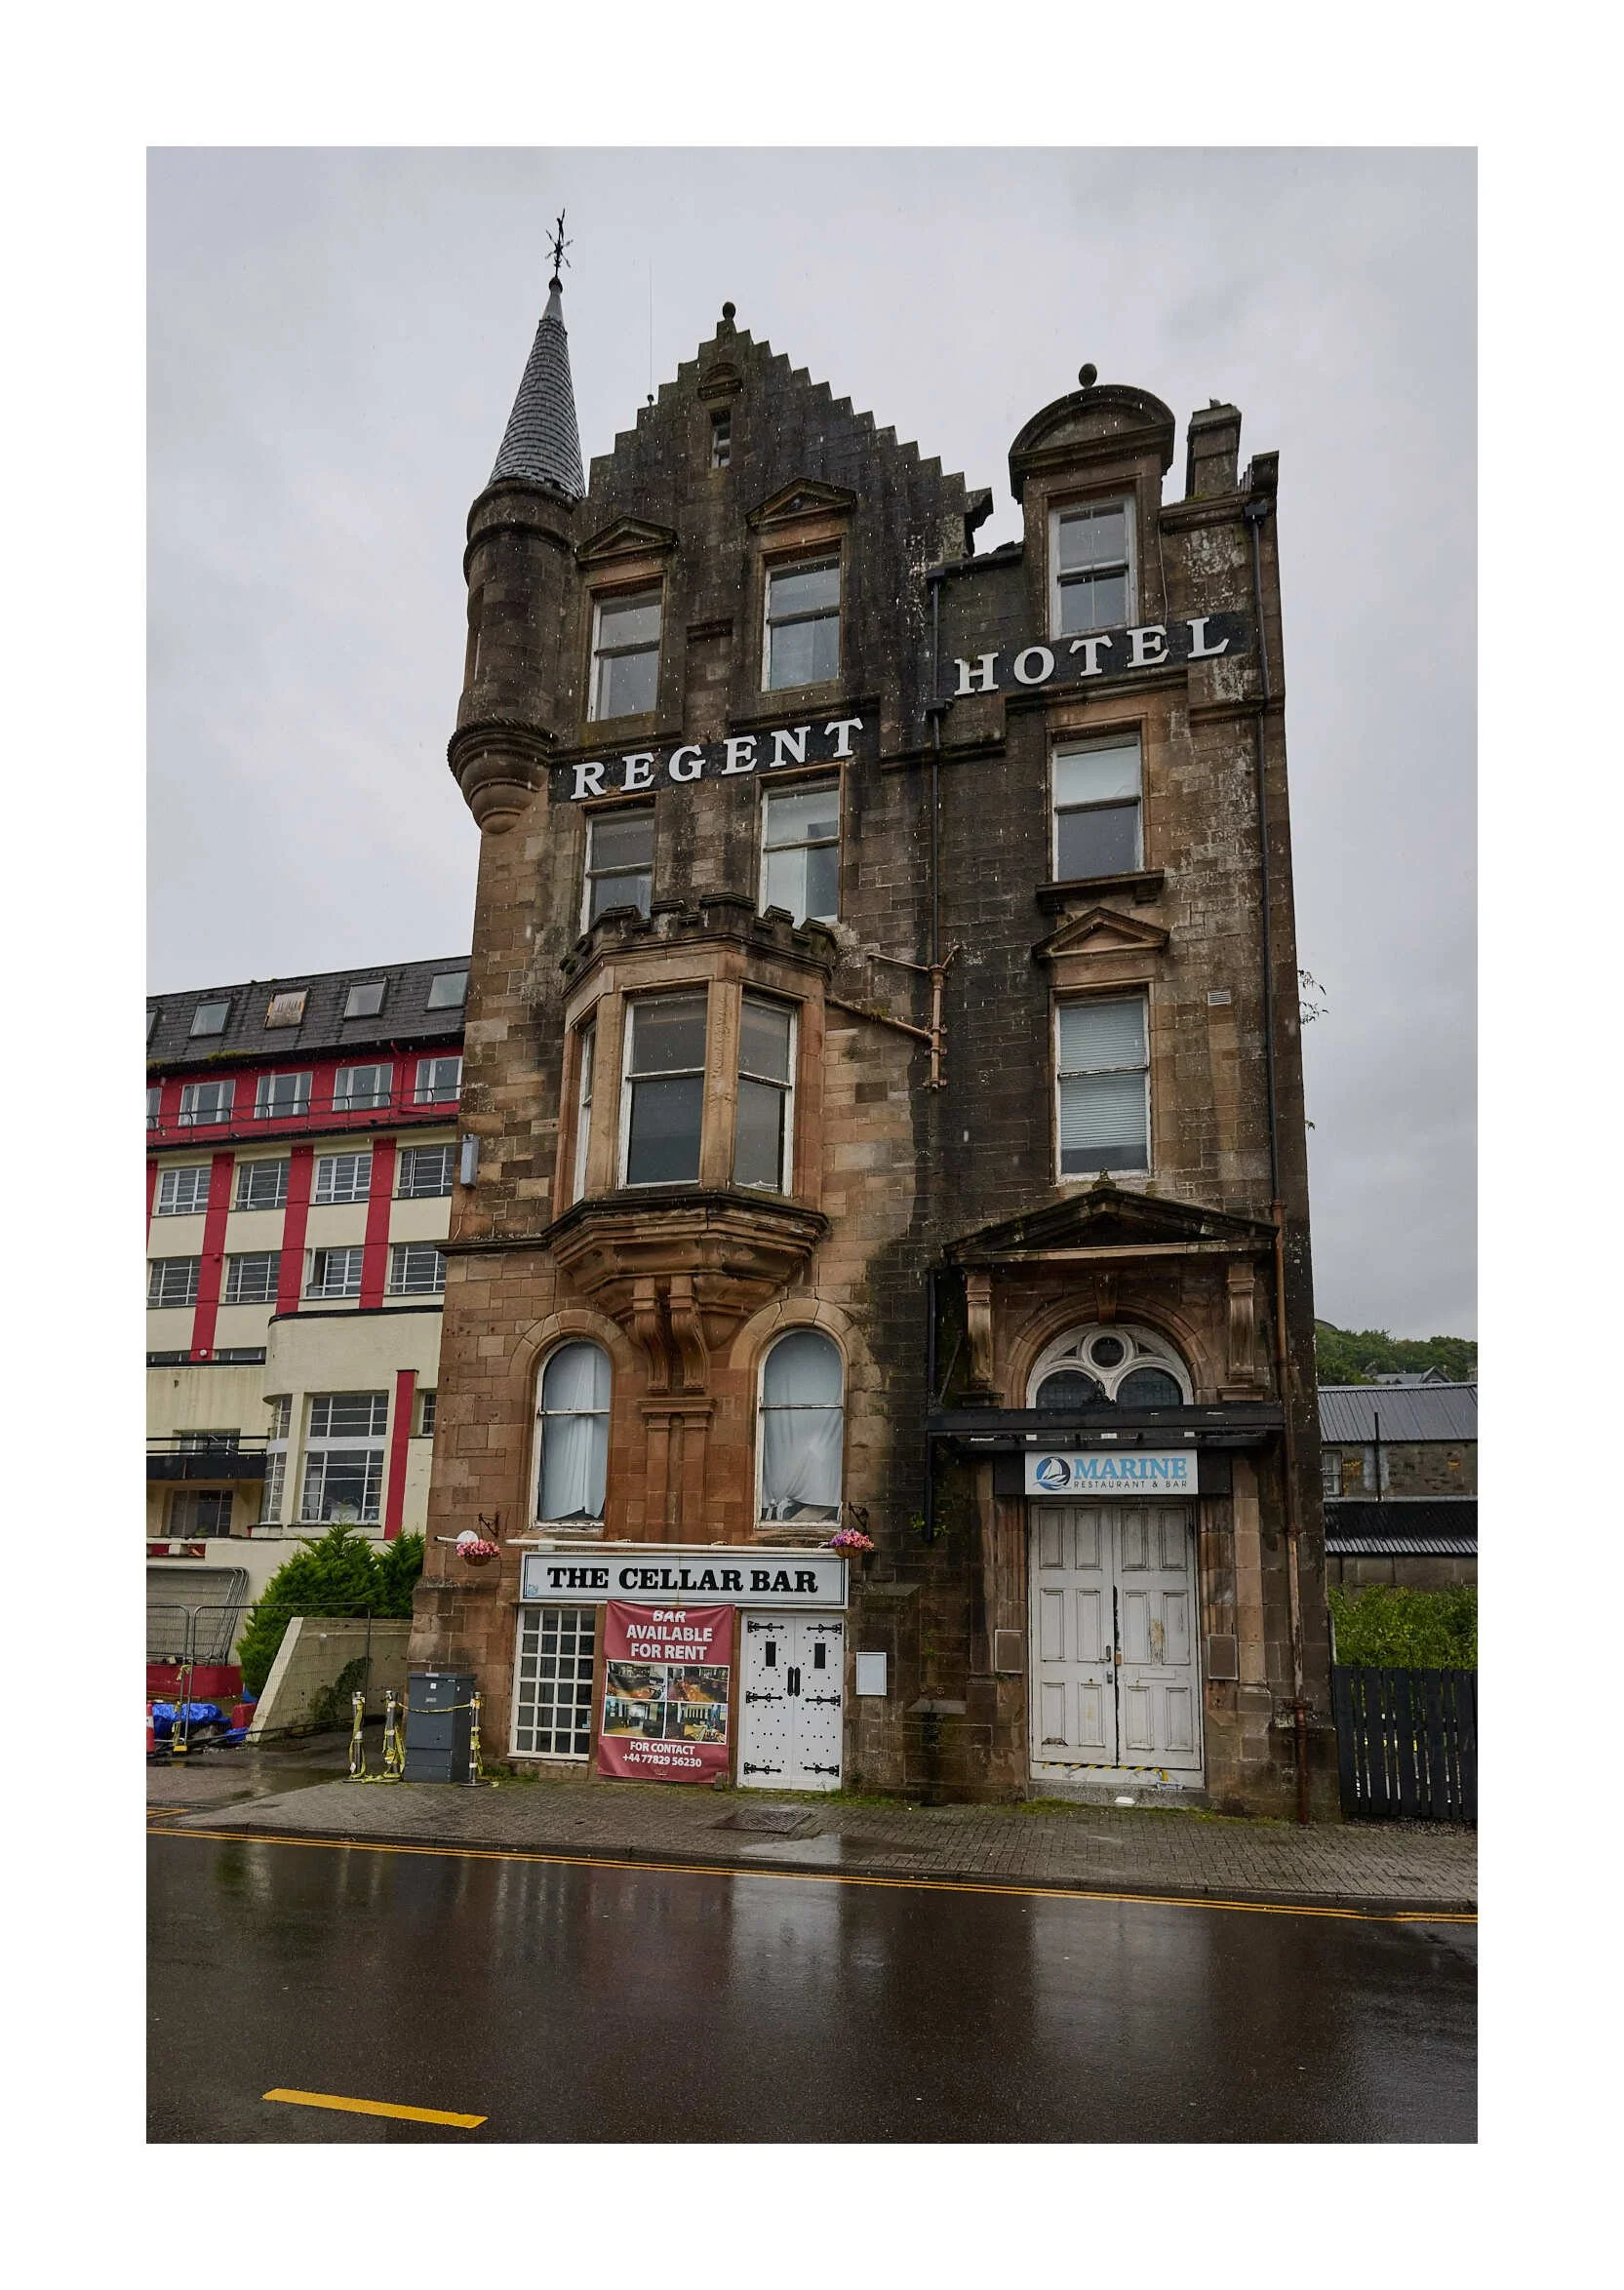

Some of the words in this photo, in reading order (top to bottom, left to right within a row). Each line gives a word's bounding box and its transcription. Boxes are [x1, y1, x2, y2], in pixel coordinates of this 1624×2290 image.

[954, 616, 1230, 695] HOTEL
[571, 718, 863, 800] REGENT
[1074, 1457, 1187, 1480] MARINE
[547, 1567, 609, 1589] THE
[618, 1567, 743, 1592] CELLAR
[749, 1570, 818, 1593] BAR
[653, 1609, 686, 1623] BAR
[626, 1624, 713, 1642] AVAILABLE
[631, 1642, 661, 1659] FOR
[664, 1644, 707, 1660] RENT
[630, 1741, 649, 1752] FOR
[651, 1743, 695, 1755] CONTACT
[622, 1753, 640, 1762] +44
[642, 1754, 670, 1765] 77829
[671, 1756, 702, 1767] 56230
